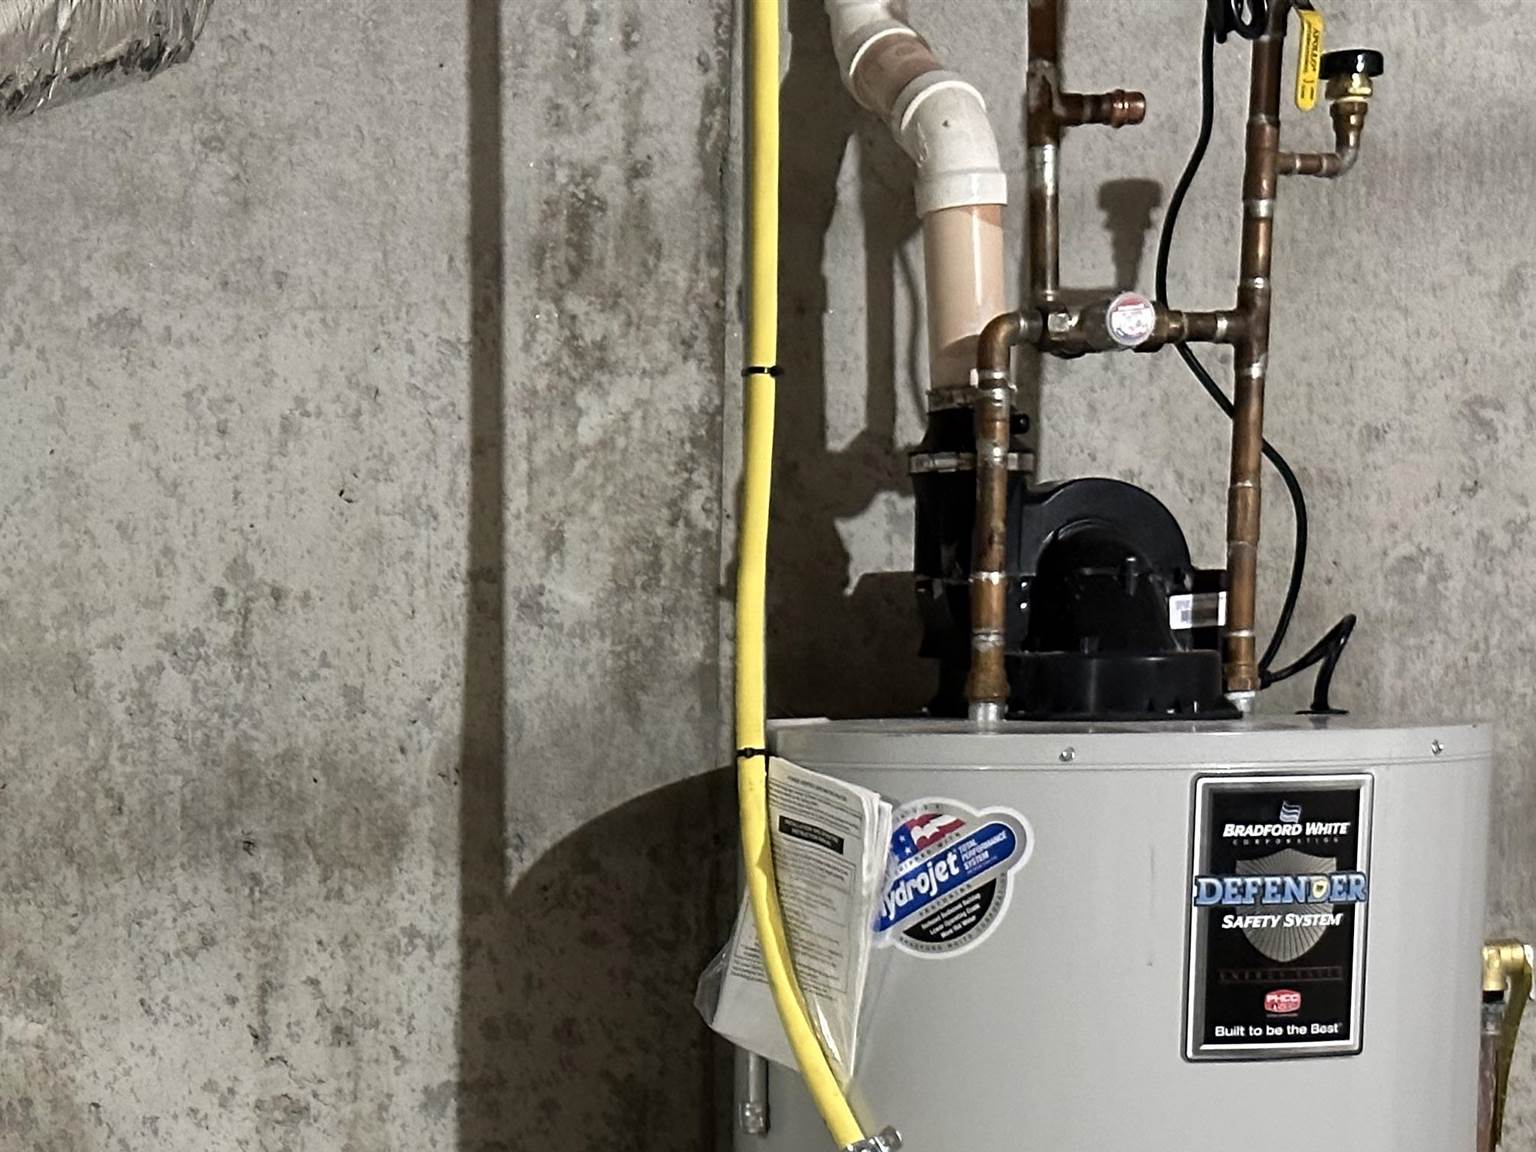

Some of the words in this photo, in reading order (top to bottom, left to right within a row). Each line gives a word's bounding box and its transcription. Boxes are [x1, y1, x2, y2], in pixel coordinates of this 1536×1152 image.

[1223, 823, 1302, 837] BRADFORD
[1305, 822, 1351, 835] WHITE
[958, 839, 977, 853] TOTAL
[962, 830, 1007, 860] PERFORMANCE
[1233, 837, 1339, 846] CORPORATION
[964, 851, 990, 870] SYSTEM
[1195, 872, 1367, 905] DEFENDER
[1222, 915, 1281, 929] SAFETY
[1283, 913, 1344, 927] SYSTEM
[1215, 1025, 1246, 1037] Built
[1249, 1025, 1262, 1036] to
[1266, 1025, 1283, 1036] be
[1287, 1024, 1307, 1035] the
[1311, 1023, 1339, 1034] Best
